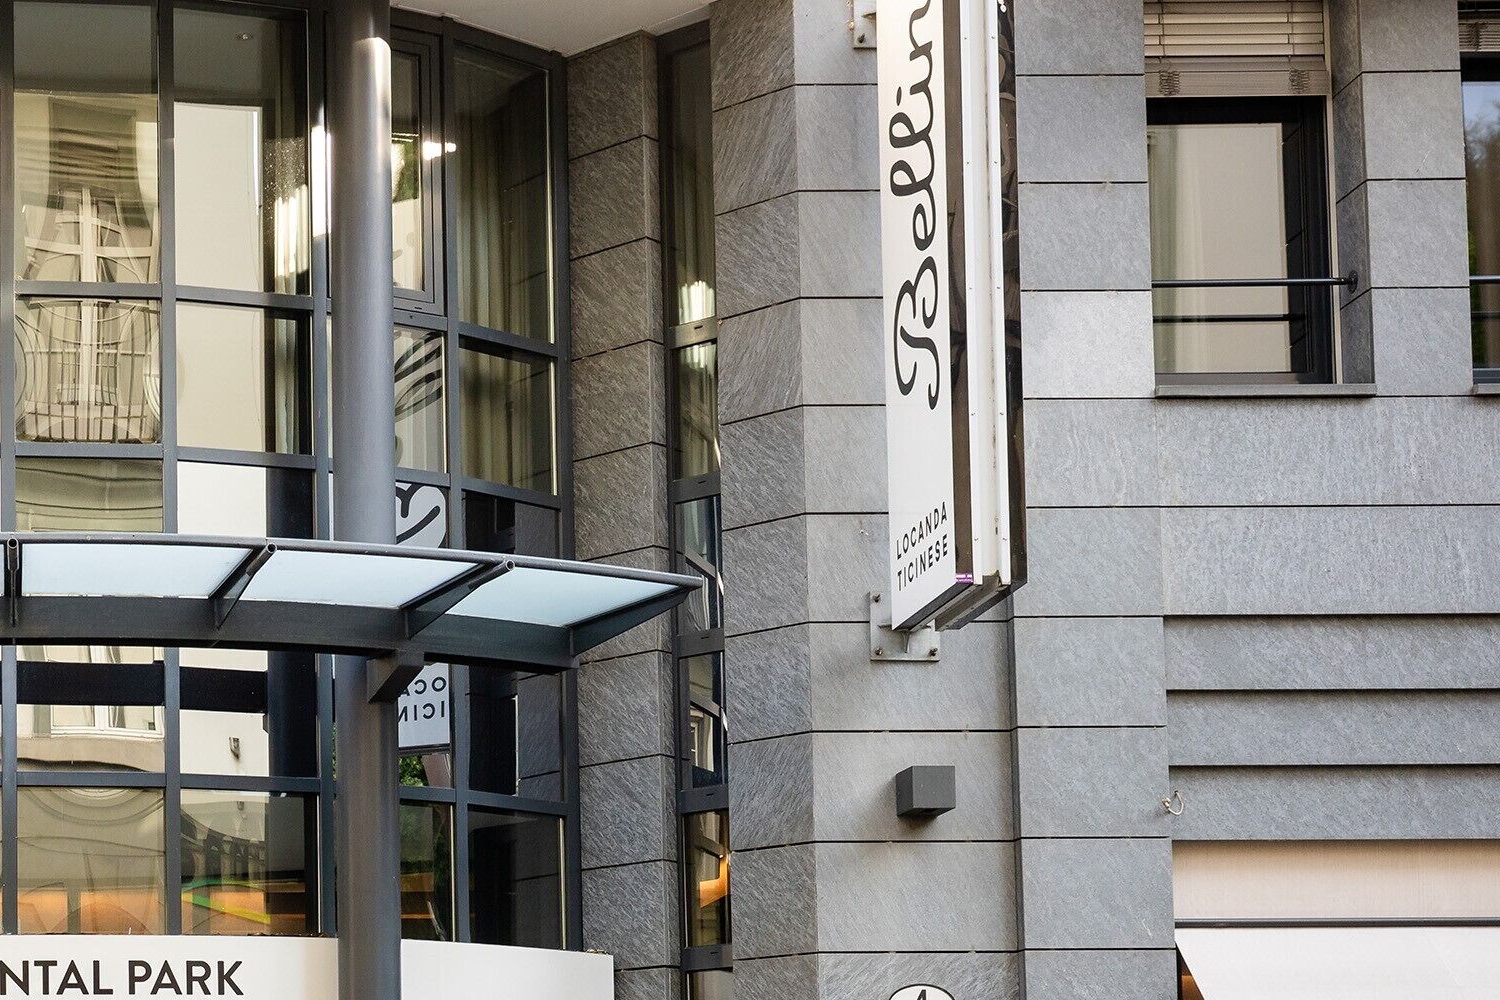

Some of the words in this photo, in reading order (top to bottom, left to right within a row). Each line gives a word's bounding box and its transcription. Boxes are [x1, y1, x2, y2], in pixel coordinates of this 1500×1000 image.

[896, 501, 948, 560] LOCANDA
[897, 533, 948, 591] TICINESE
[128, 960, 244, 996] PARK
